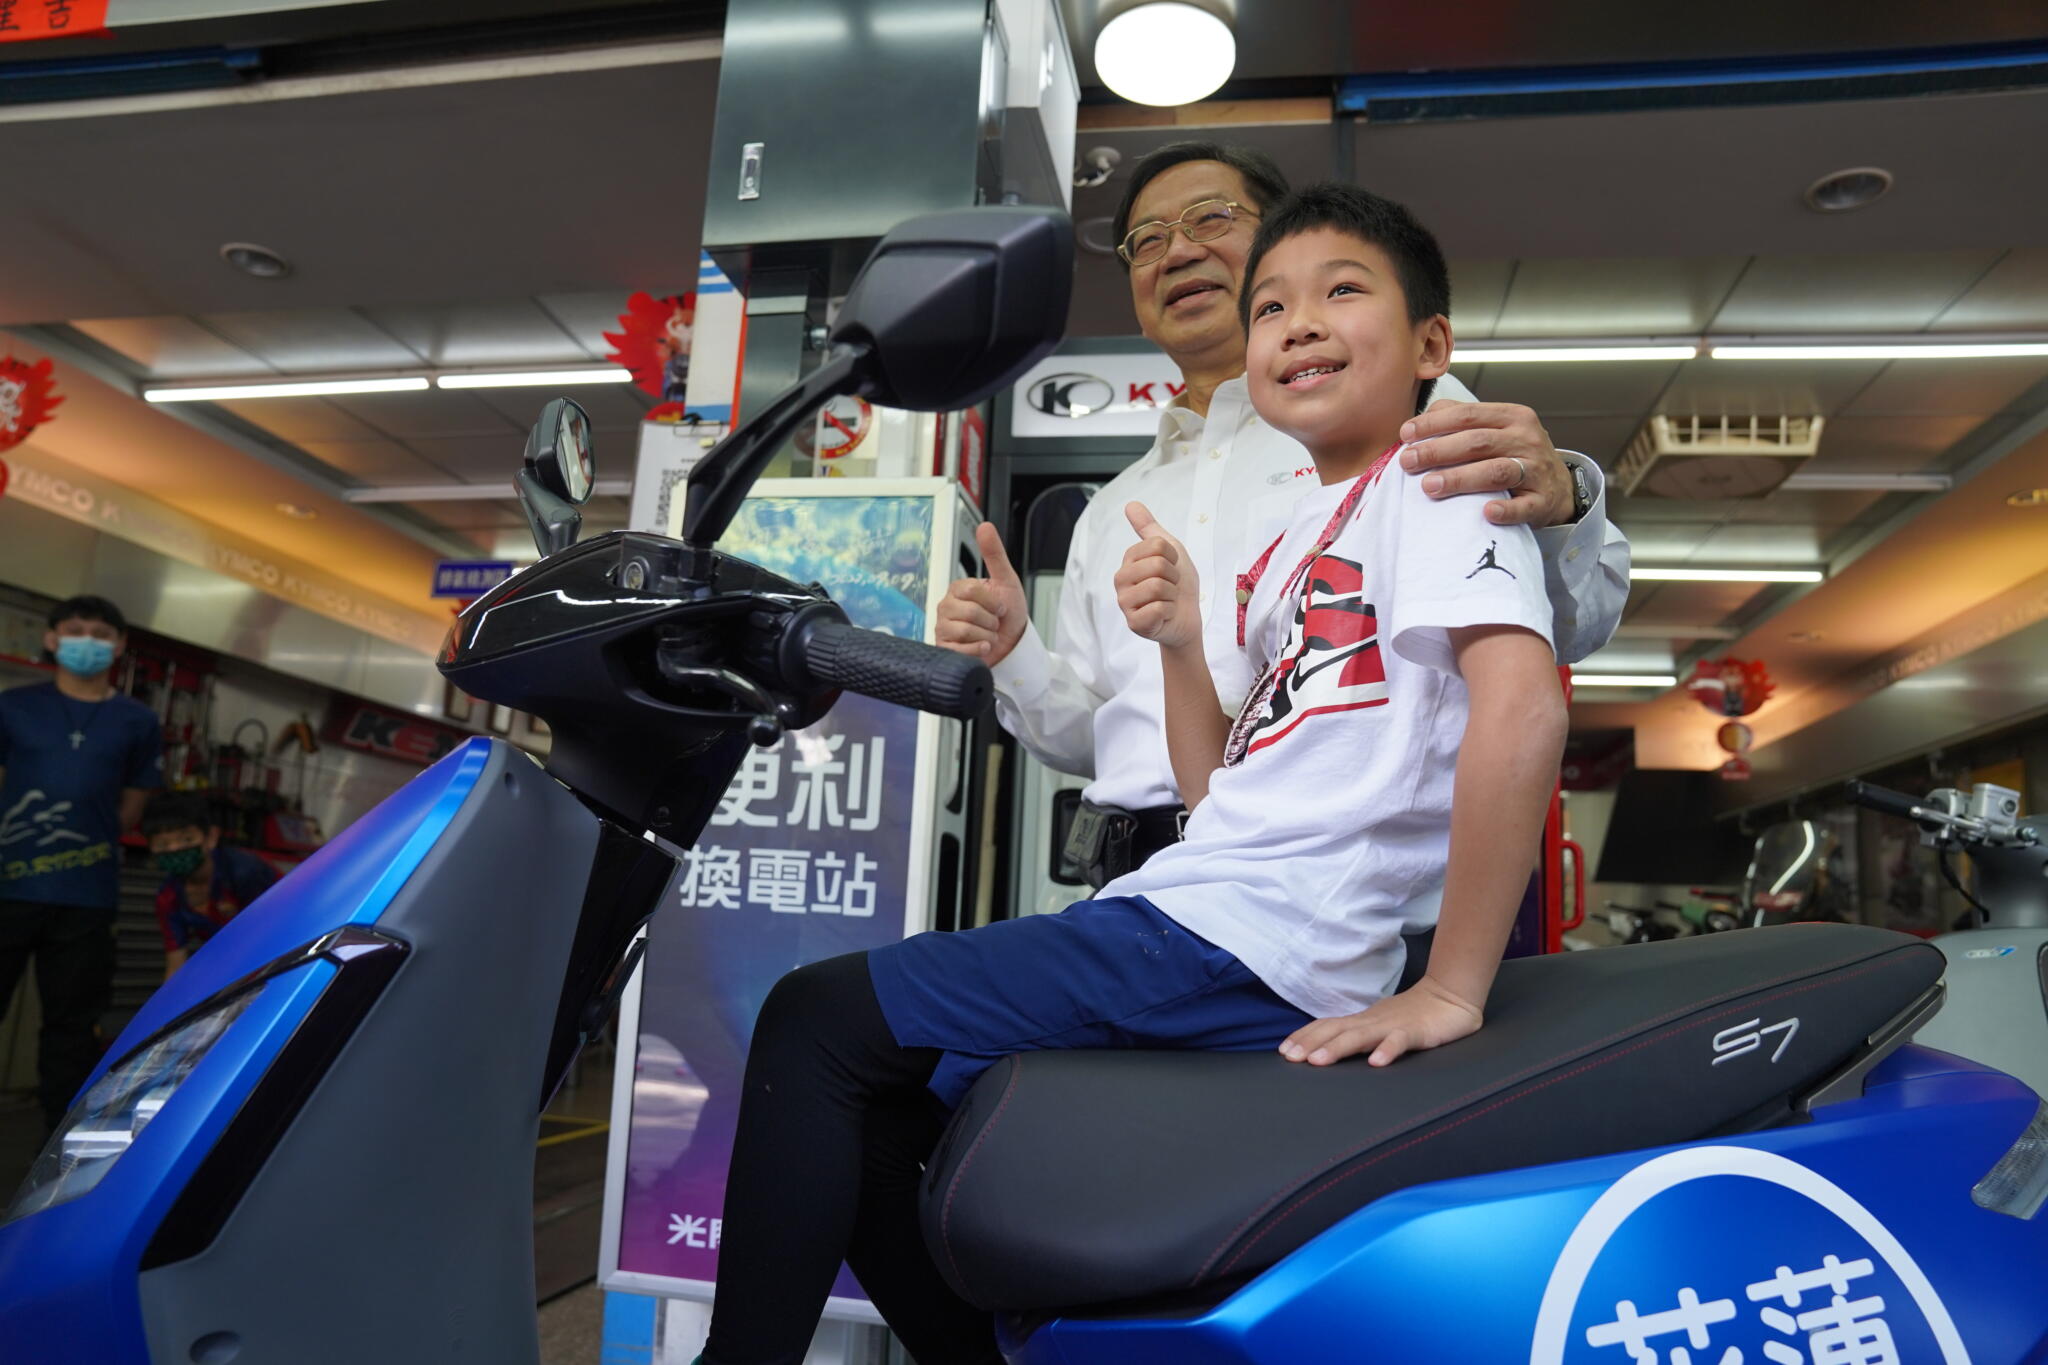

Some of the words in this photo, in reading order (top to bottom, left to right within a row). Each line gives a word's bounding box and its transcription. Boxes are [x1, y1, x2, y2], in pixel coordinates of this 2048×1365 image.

[8, 464, 95, 513] YMCO
[680, 845, 878, 917] 換電站
[1711, 1017, 1799, 1066] S7
